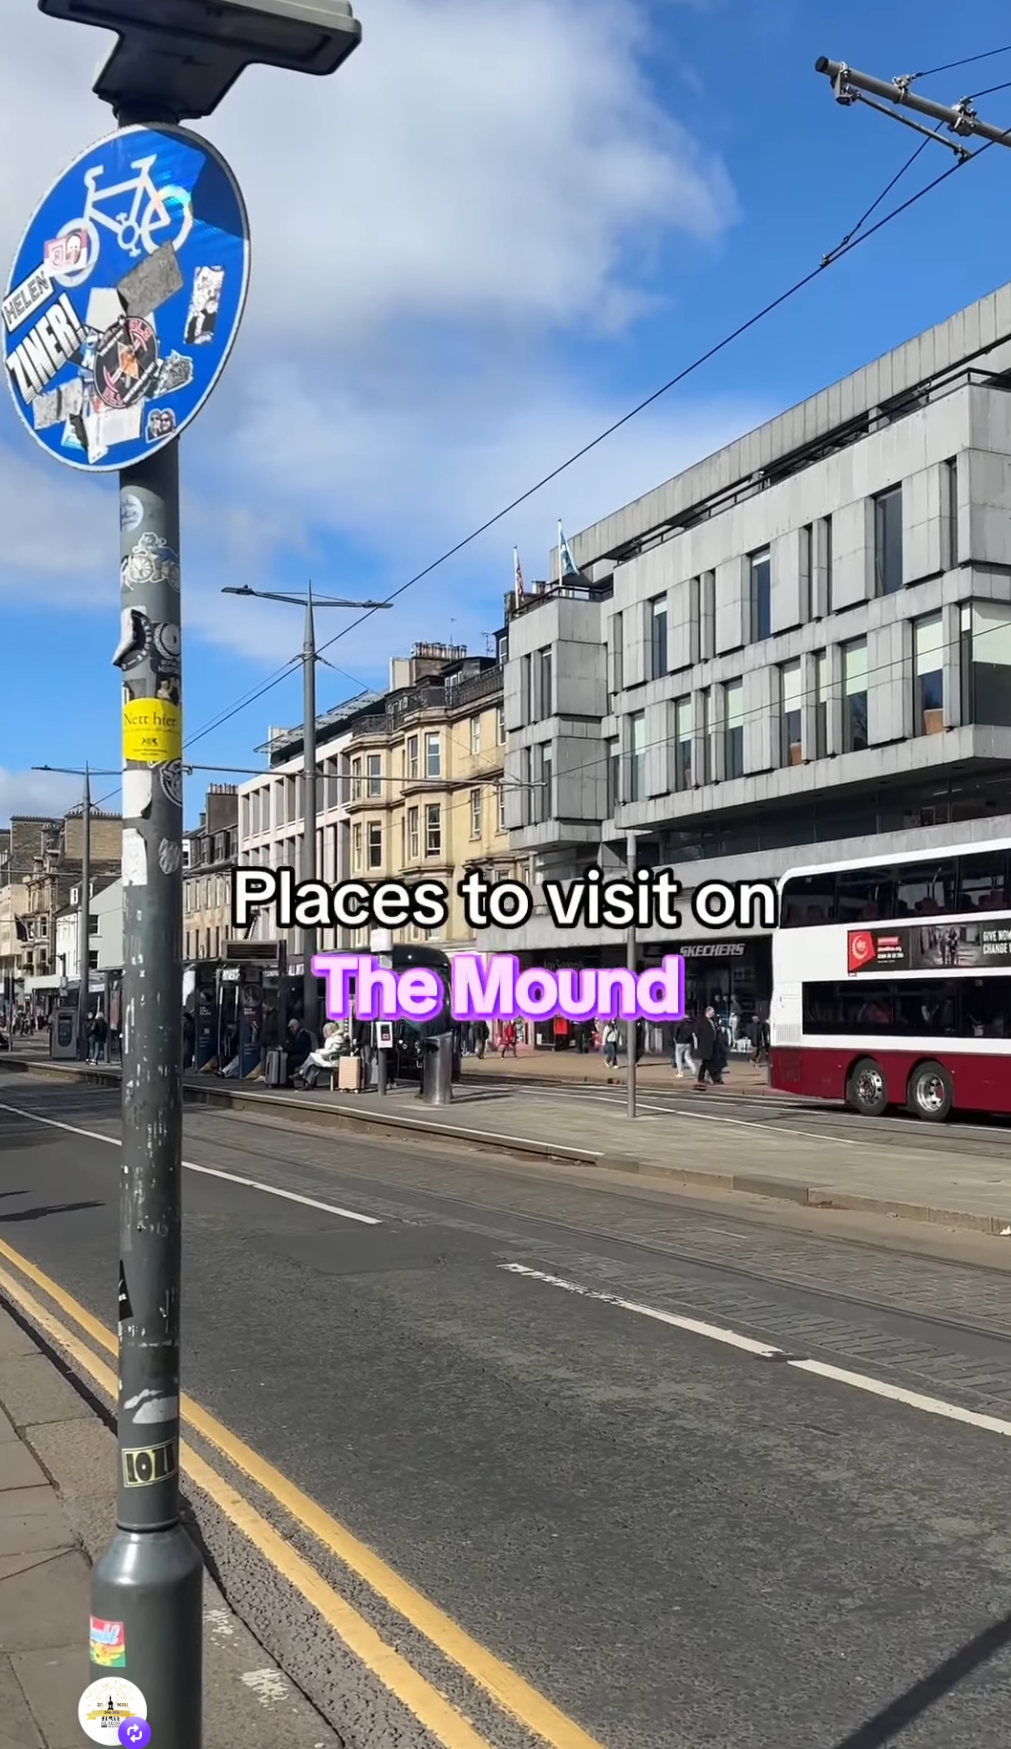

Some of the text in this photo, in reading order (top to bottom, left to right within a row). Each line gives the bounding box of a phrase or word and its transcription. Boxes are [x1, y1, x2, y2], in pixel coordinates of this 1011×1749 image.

[4, 271, 50, 324] HELEN
[5, 292, 88, 406] ZINER!
[123, 712, 150, 726] Nett
[679, 942, 746, 957] SKECHERS
